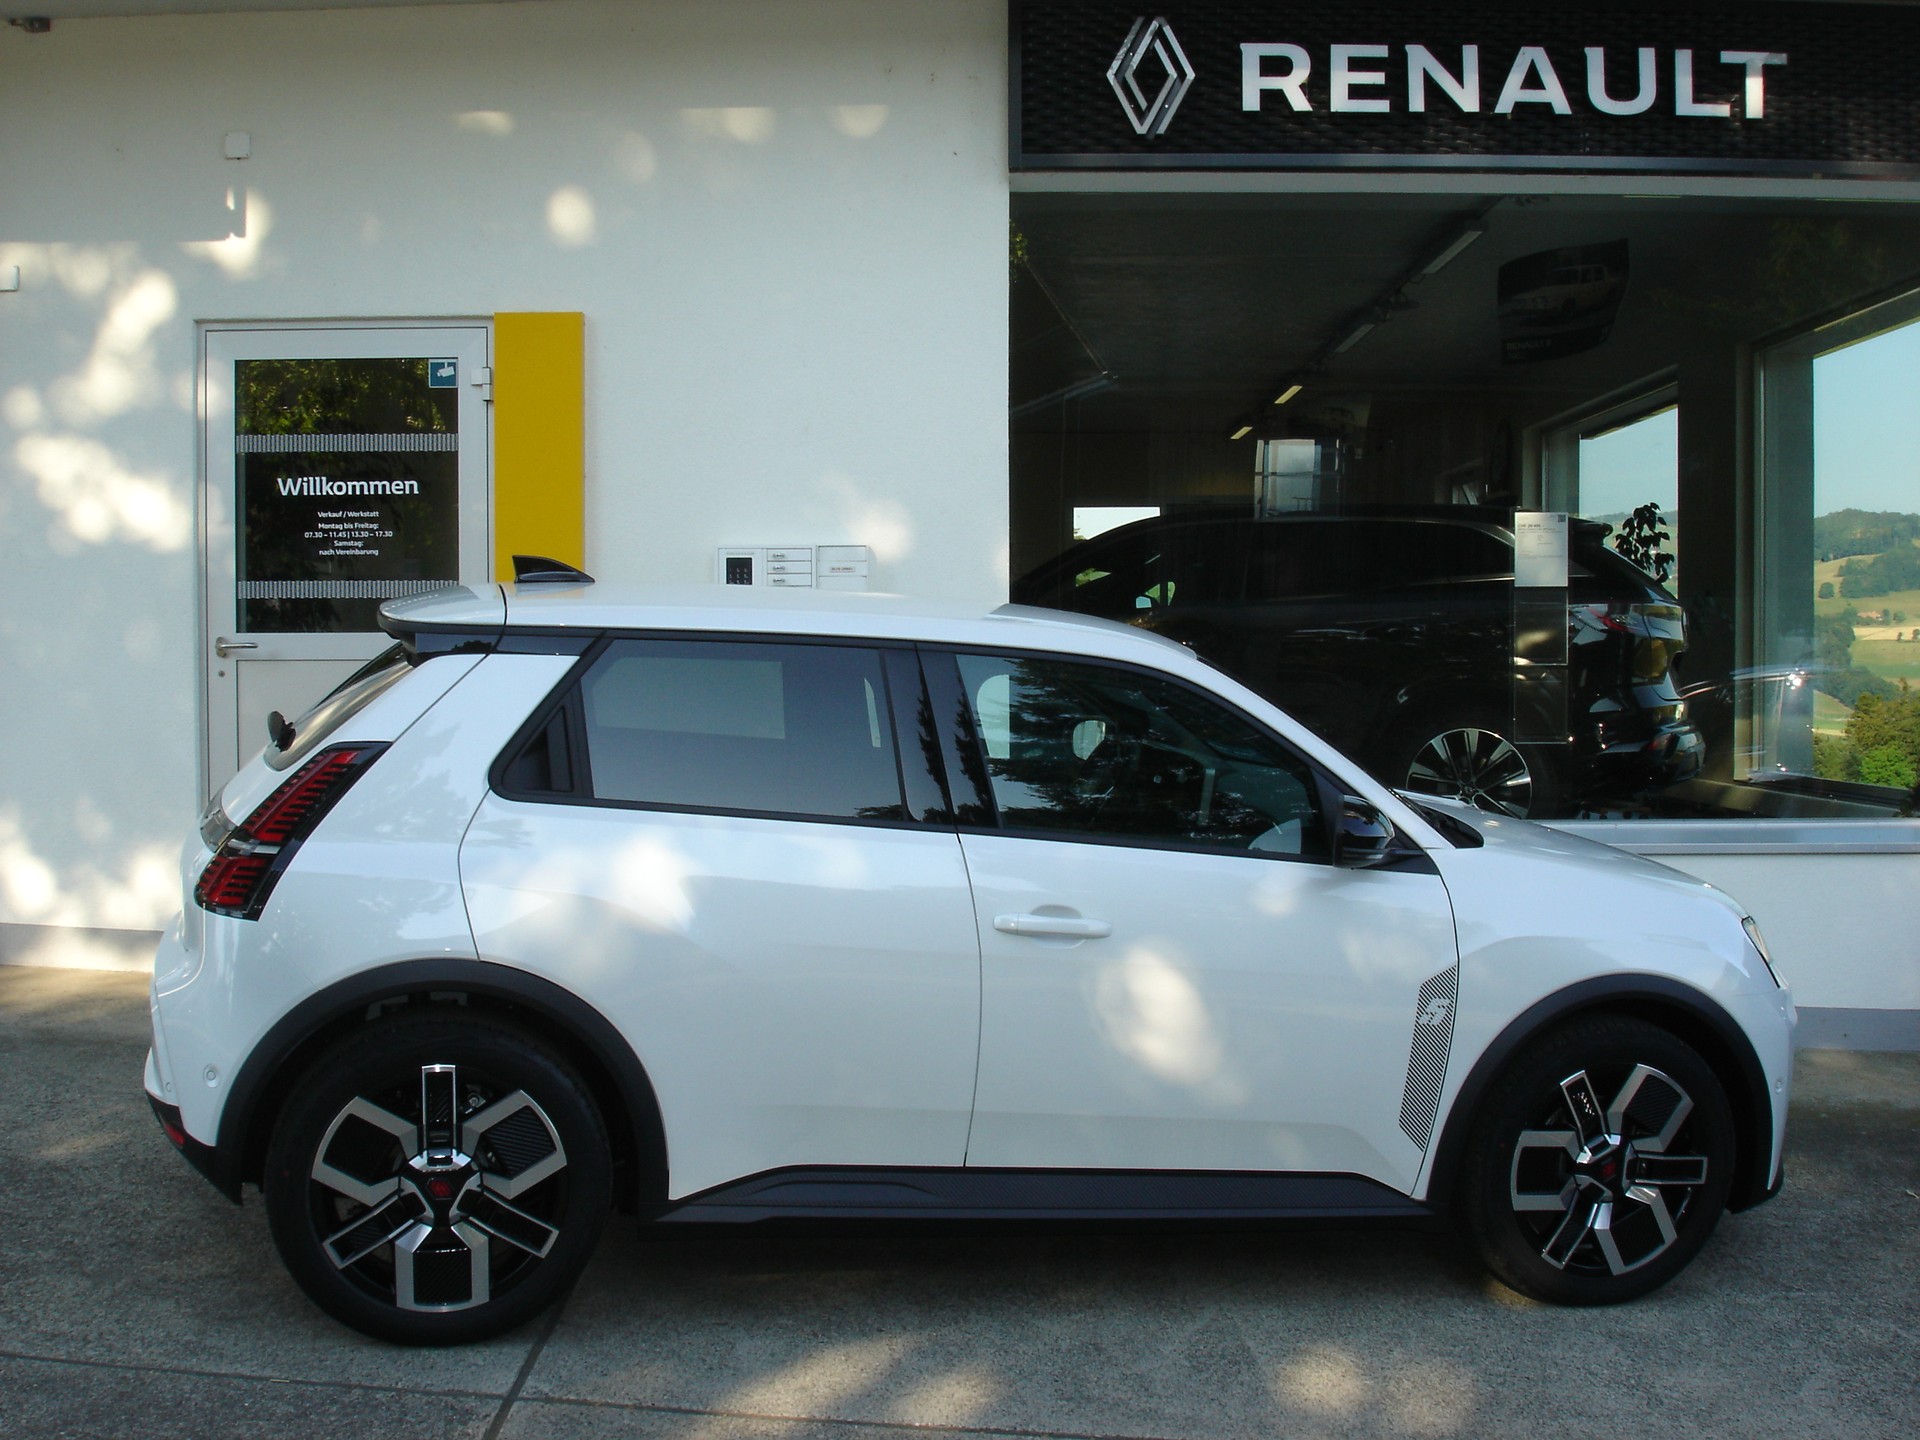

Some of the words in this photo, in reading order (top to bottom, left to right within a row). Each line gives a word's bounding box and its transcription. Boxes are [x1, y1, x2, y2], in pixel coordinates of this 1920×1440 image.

[1239, 42, 1788, 119] RENAULT
[277, 476, 419, 496] Willkommen
[354, 522, 379, 530] Freitag:
